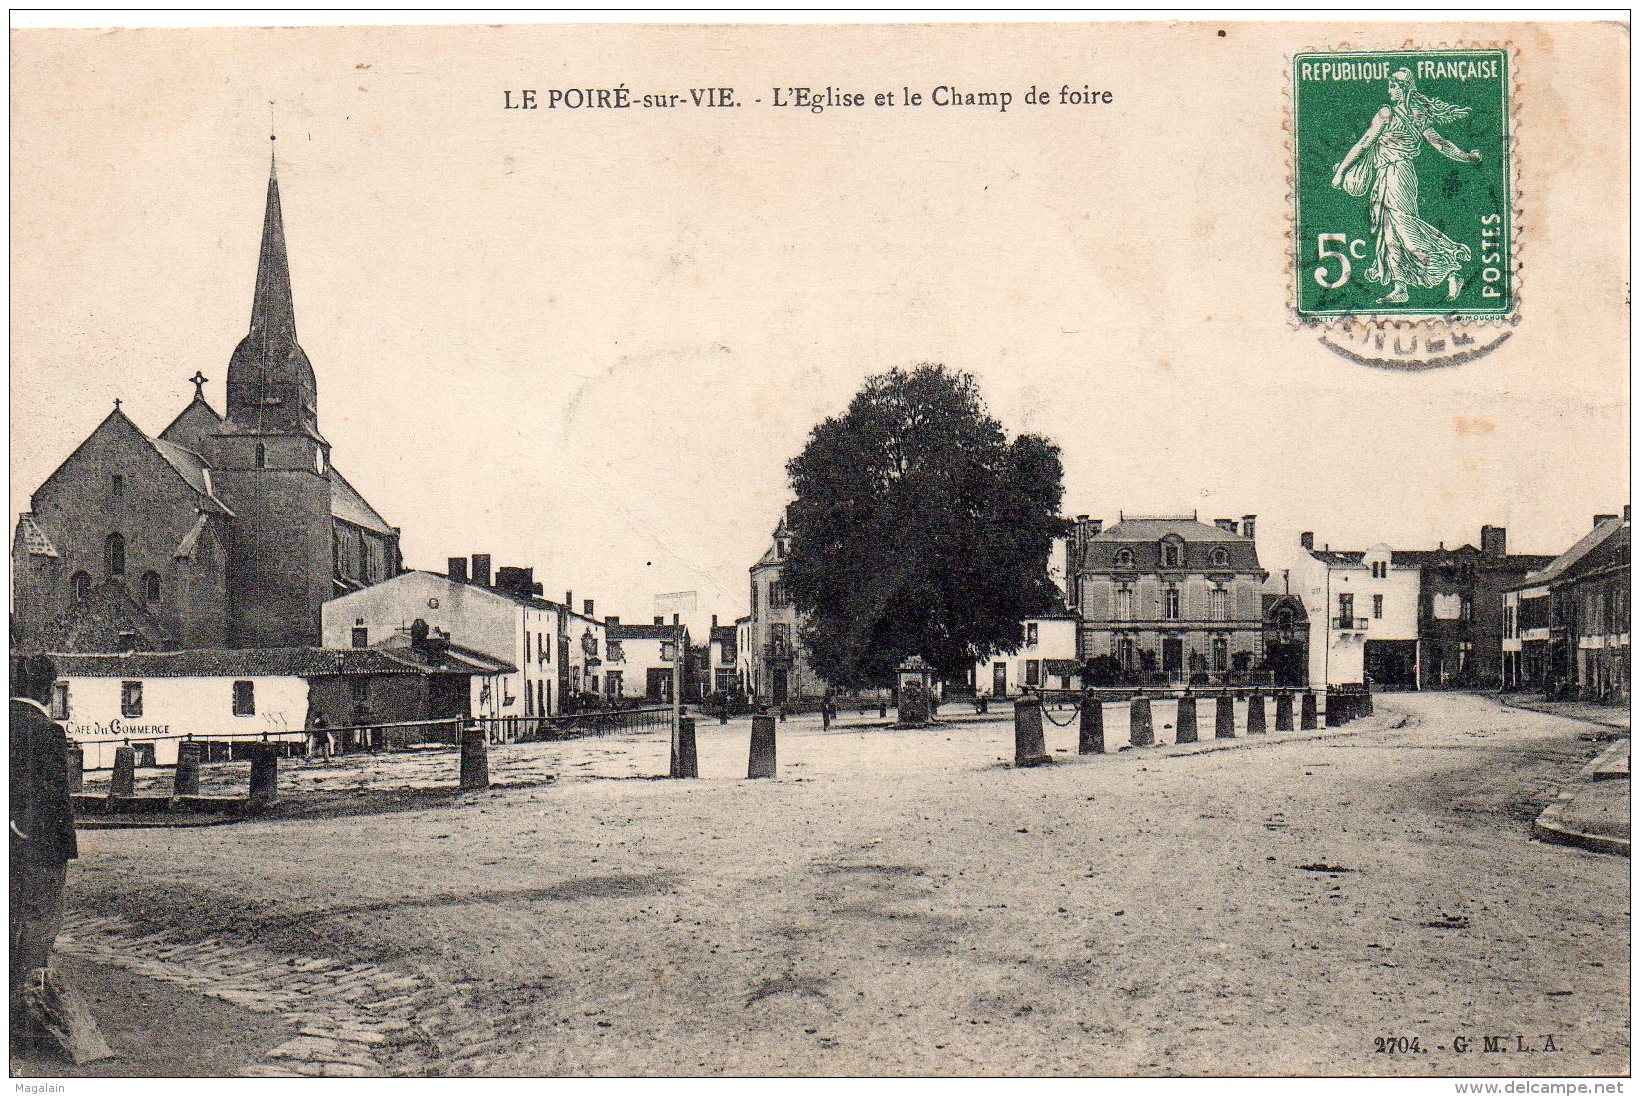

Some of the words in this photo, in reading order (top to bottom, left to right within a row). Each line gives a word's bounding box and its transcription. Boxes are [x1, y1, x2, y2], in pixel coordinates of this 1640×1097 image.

[1301, 61, 1391, 82] REPUBLIQUE
[1417, 60, 1499, 81] FRANÇAISE
[1481, 213, 1501, 298] POSTES
[109, 718, 170, 735] COMMERCE
